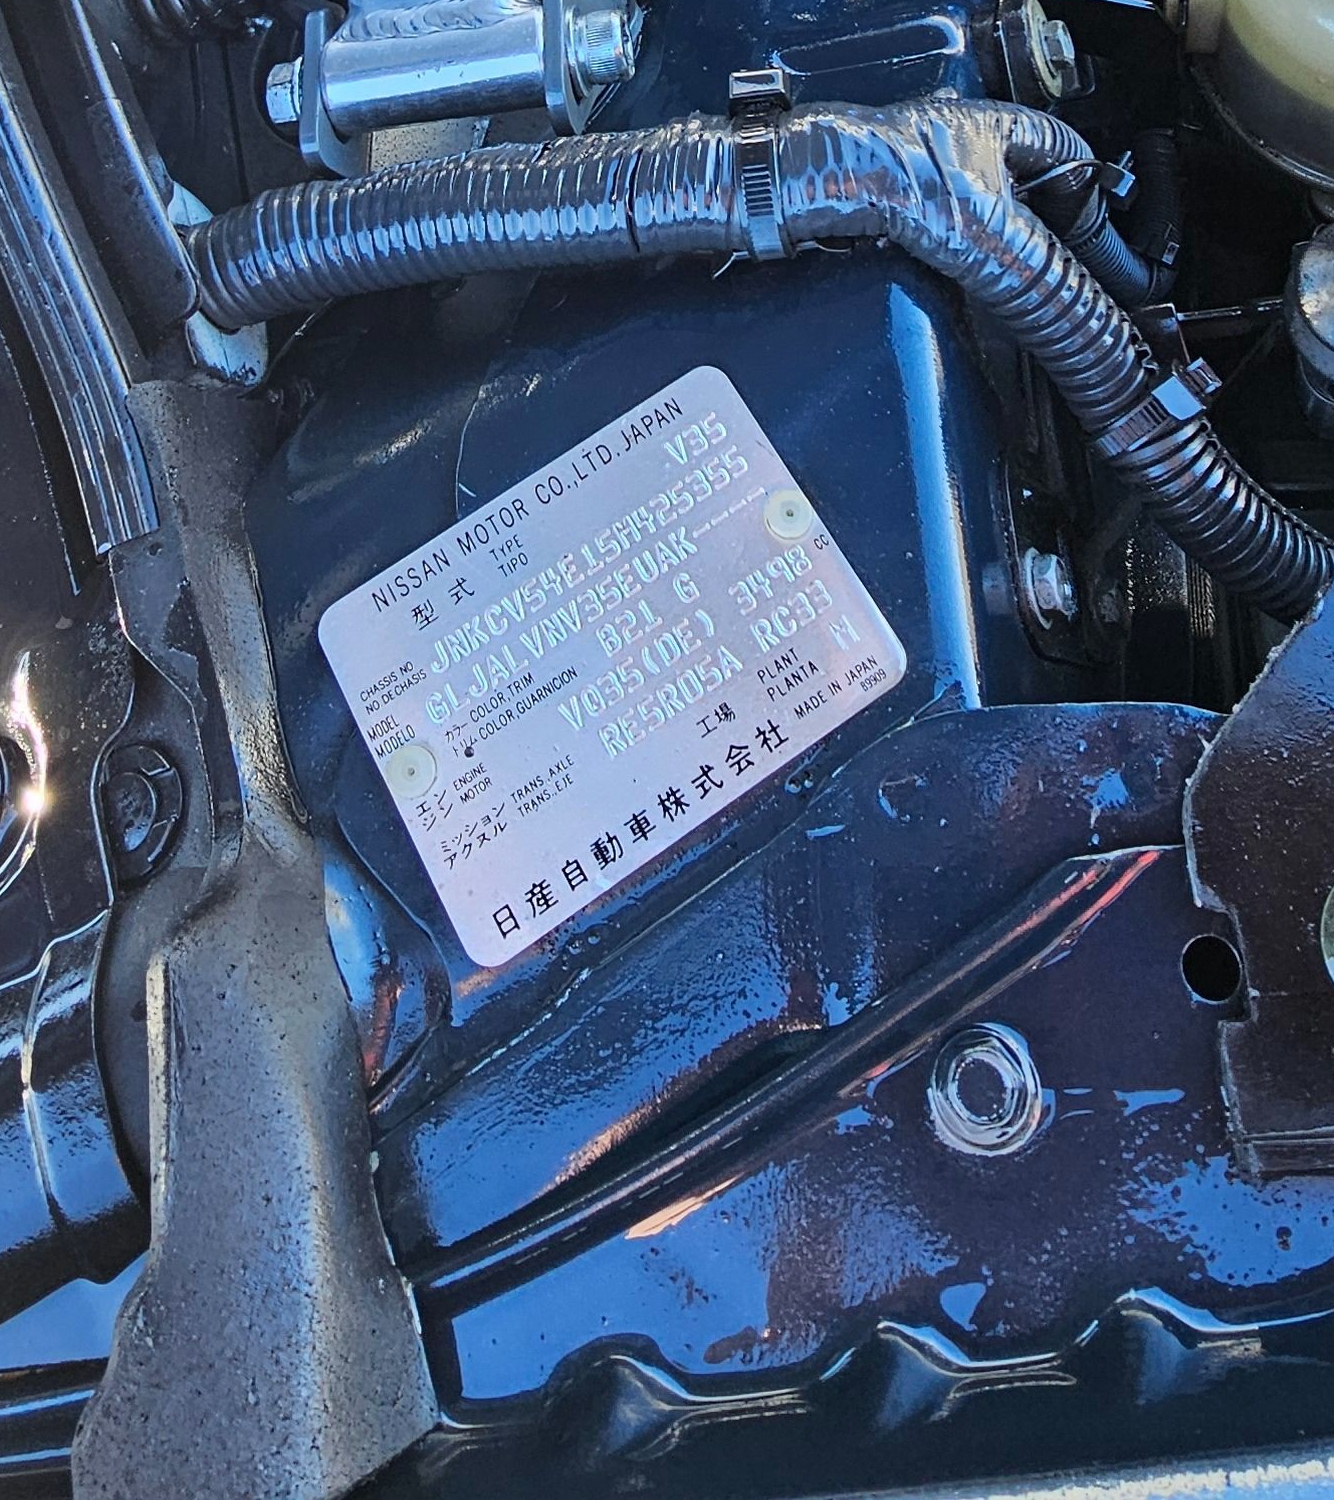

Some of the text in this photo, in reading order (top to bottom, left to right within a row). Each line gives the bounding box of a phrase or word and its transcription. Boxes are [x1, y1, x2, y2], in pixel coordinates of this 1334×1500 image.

[663, 409, 729, 468] V35
[370, 547, 451, 612] NISSAN
[455, 497, 529, 555] MOTOR
[615, 397, 684, 453] JAPAN
[489, 534, 523, 562] TYPE
[497, 551, 529, 578] TIPO
[728, 543, 814, 616] 3498
[409, 574, 476, 630] 型式
[594, 570, 700, 658] B21 G
[749, 578, 835, 654] RC33
[828, 612, 860, 652] M
[359, 660, 414, 702] CHASSIS NO
[756, 647, 800, 684] PLANT
[766, 659, 819, 701] PLANTA
[793, 654, 878, 719] MADE IN JAPAN
[364, 668, 427, 714] NO DE CHASIS
[467, 672, 536, 723] COLOR,TRIM
[477, 666, 578, 741] COLOR,GUARNICION
[366, 713, 399, 741] MODEL
[444, 719, 469, 742] カラー
[694, 700, 737, 738] 工場
[374, 724, 416, 759] MODELO
[452, 733, 478, 757] トリム
[451, 761, 486, 791] ENGINE
[459, 776, 493, 804] MOTOR
[413, 787, 449, 817] エン
[438, 801, 508, 854] ミッション
[442, 818, 509, 870] アクスル
[491, 715, 789, 939] 日産自動車株式会社
